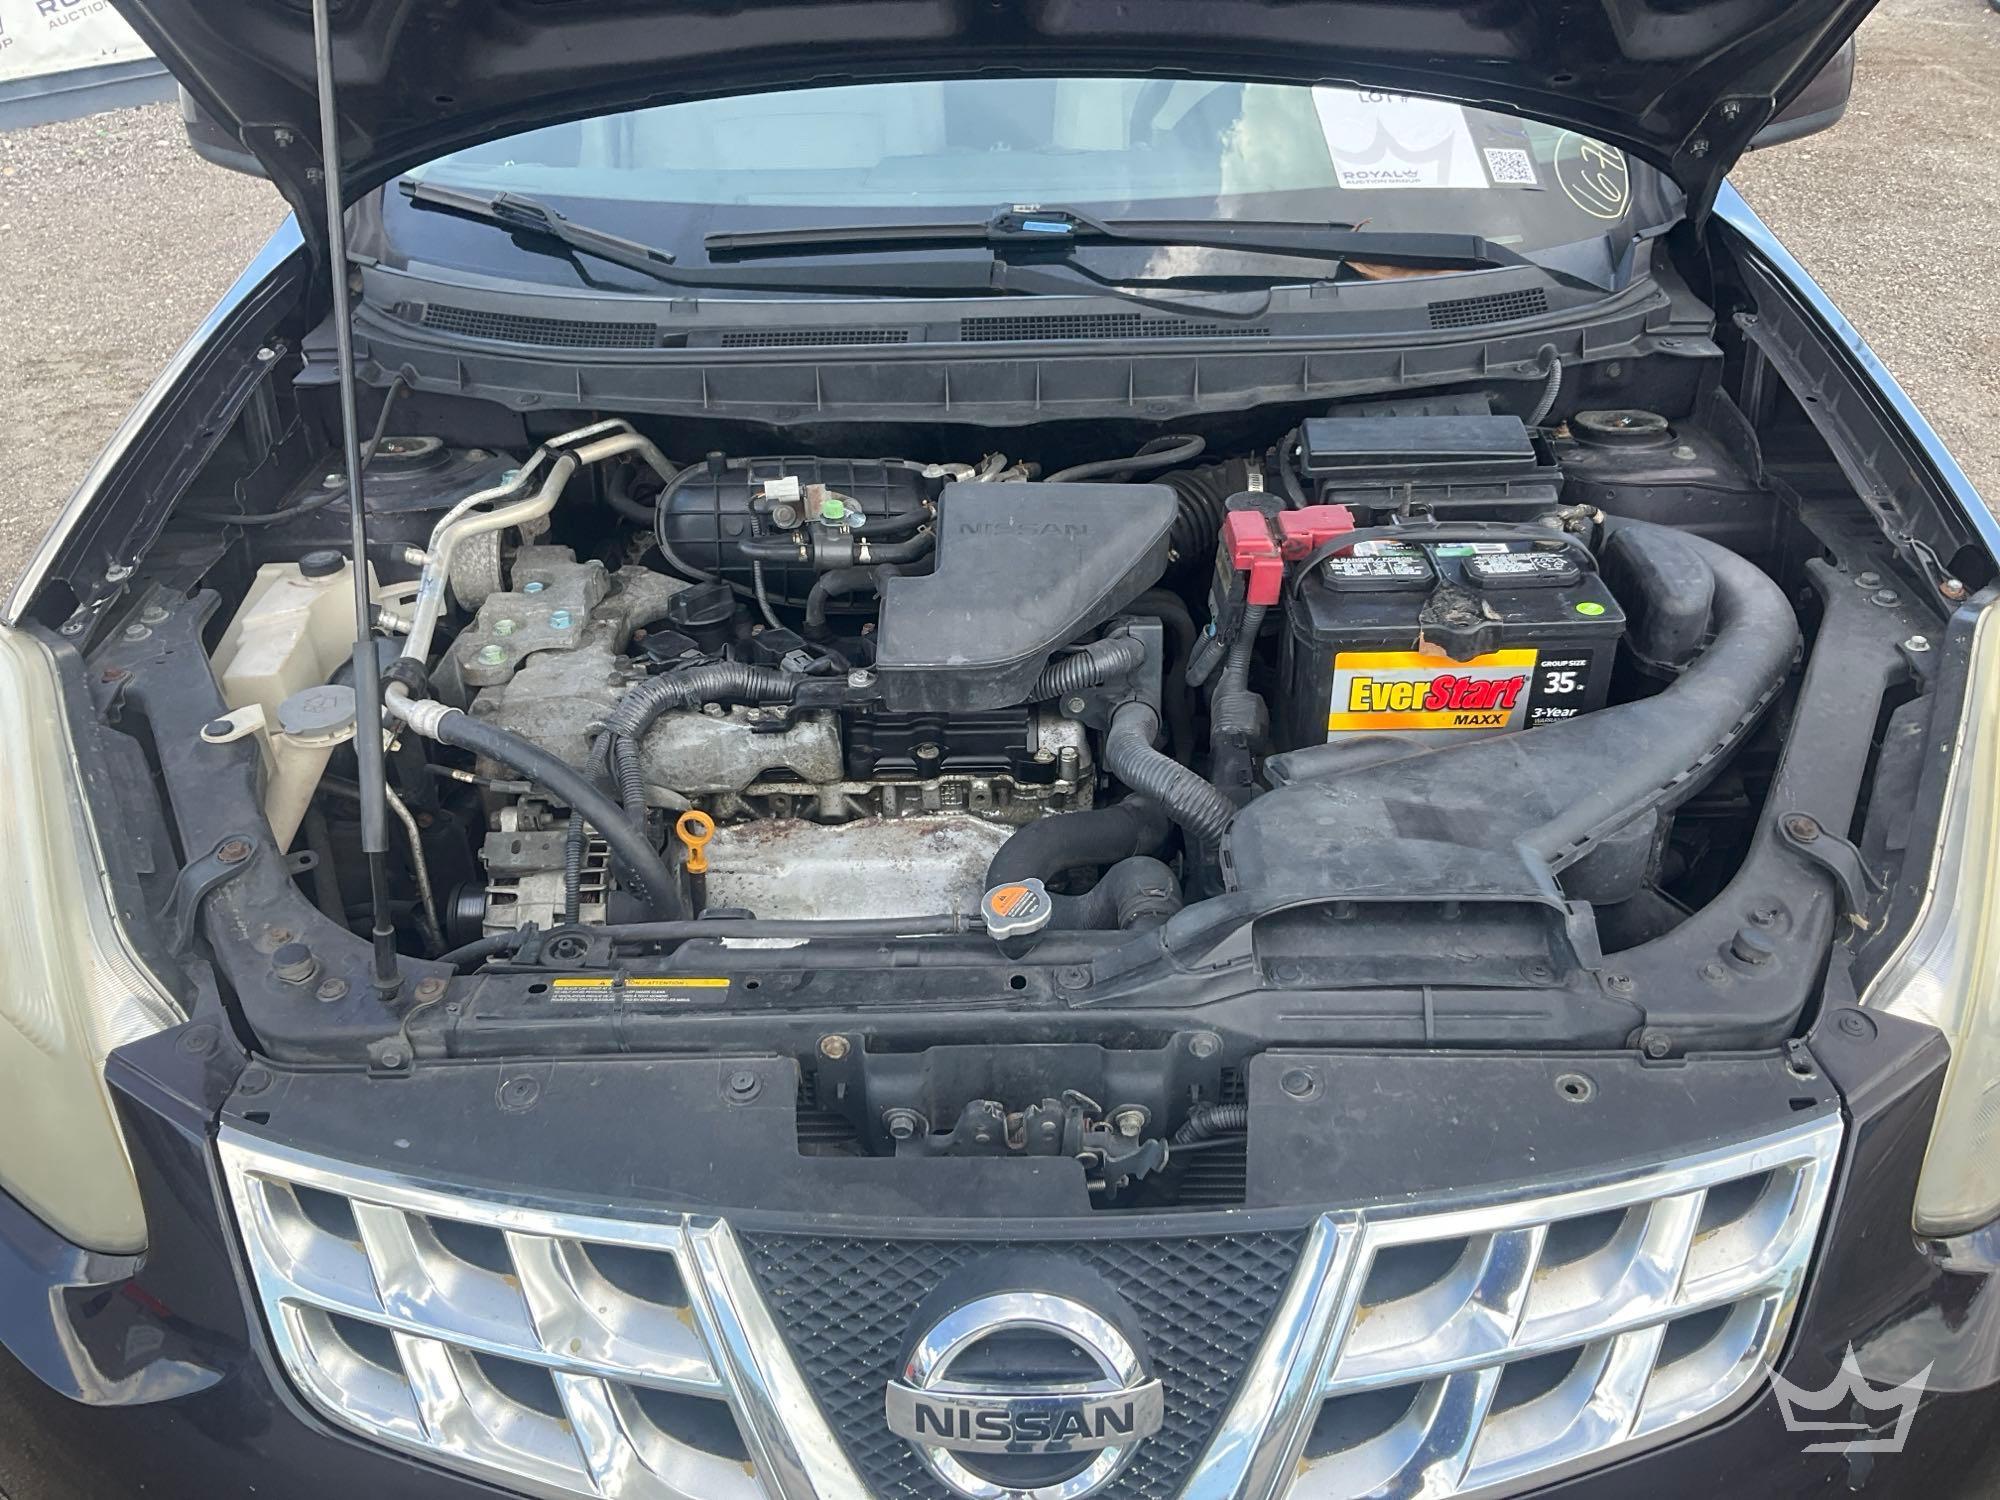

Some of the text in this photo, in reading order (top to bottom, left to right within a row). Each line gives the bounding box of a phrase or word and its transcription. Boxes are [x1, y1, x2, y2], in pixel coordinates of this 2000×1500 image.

[1343, 170, 1403, 179] ROYAL
[959, 523, 1089, 536] NISSAN
[1541, 659, 1586, 668] GROUP SIZE
[1544, 671, 1577, 694] 35
[1349, 675, 1525, 711] EverStart
[1531, 707, 1578, 718] 3-Year
[1453, 713, 1503, 725] MAXX
[915, 1401, 1135, 1441] NISSAN
